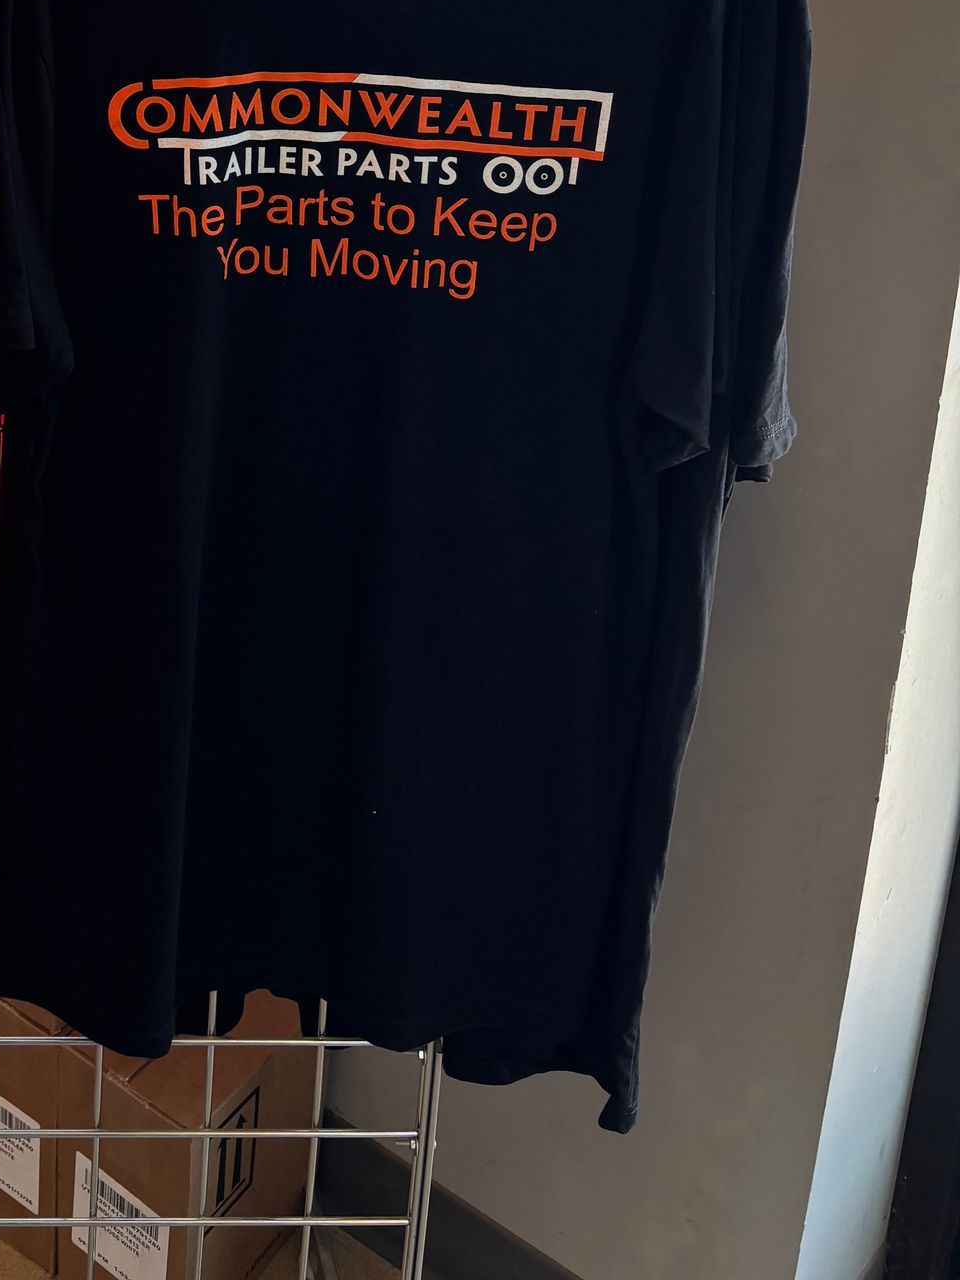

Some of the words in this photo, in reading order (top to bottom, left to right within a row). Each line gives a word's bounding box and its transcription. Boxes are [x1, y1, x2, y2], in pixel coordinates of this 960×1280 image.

[108, 81, 587, 149] COMMONWEALTH
[183, 146, 324, 186] TRAILER
[336, 147, 458, 186] PARTS
[138, 193, 225, 238] The
[235, 185, 355, 227] Parts
[371, 191, 416, 236] to
[433, 196, 558, 252] Keep
[310, 237, 478, 300] Moving
